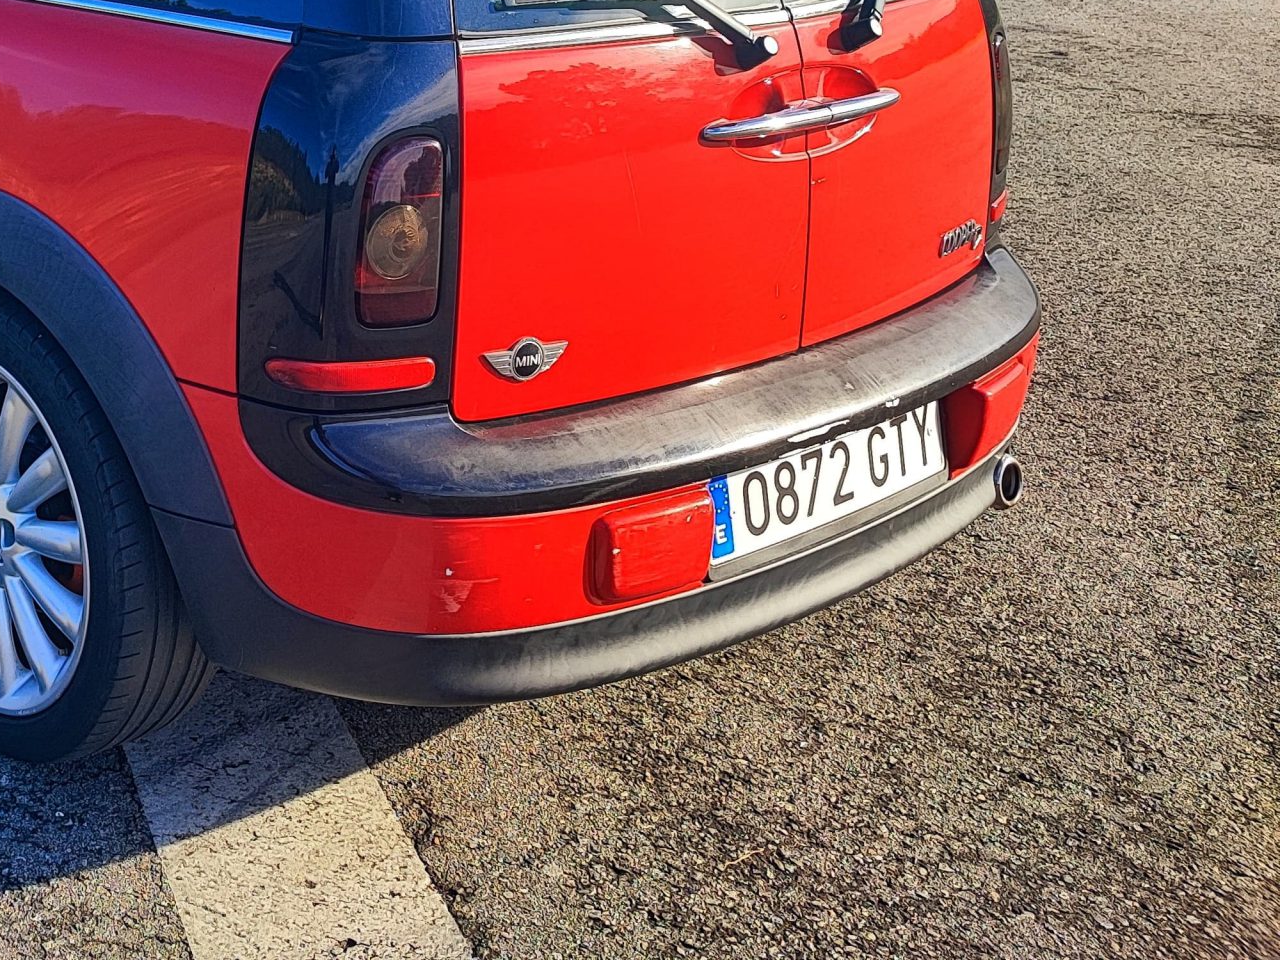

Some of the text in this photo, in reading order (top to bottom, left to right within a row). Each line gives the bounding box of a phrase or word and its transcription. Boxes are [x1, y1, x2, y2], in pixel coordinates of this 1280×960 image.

[515, 353, 541, 368] MINI
[742, 403, 929, 537] 0872 GTY
[714, 523, 728, 545] E
